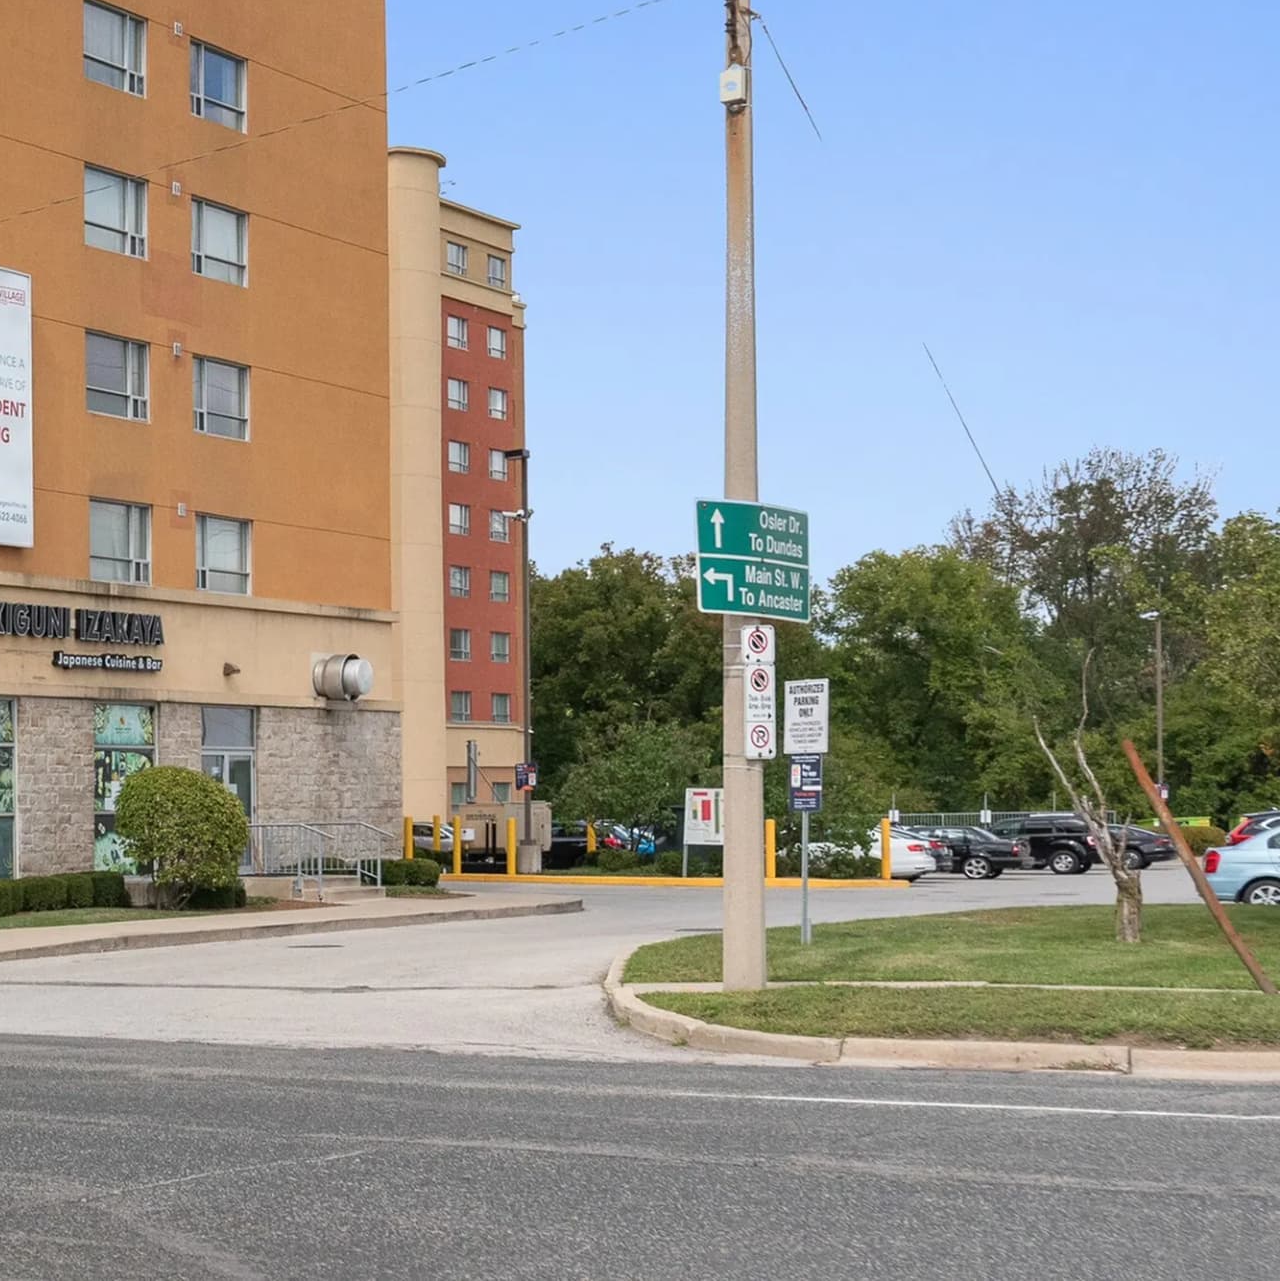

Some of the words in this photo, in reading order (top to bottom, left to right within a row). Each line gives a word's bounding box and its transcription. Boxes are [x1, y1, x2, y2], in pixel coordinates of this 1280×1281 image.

[18, 358, 25, 368] A
[14, 379, 26, 391] OF
[759, 511, 788, 531] Osler
[789, 516, 804, 534] Dr.
[748, 532, 764, 552] To
[766, 535, 803, 558] Dundas
[745, 565, 772, 586] Main
[774, 569, 788, 588] St.
[790, 572, 803, 591] W.
[739, 587, 755, 606] To
[758, 590, 804, 613] Ancaster
[75, 608, 164, 646] IZAKAYA
[57, 652, 103, 668] Japanese
[104, 654, 137, 669] Cuisine
[137, 658, 145, 669] &
[146, 659, 162, 670] Bar
[788, 683, 825, 695] AUTHORIZED
[793, 695, 820, 707] PARKING
[798, 707, 814, 718] ONLY
